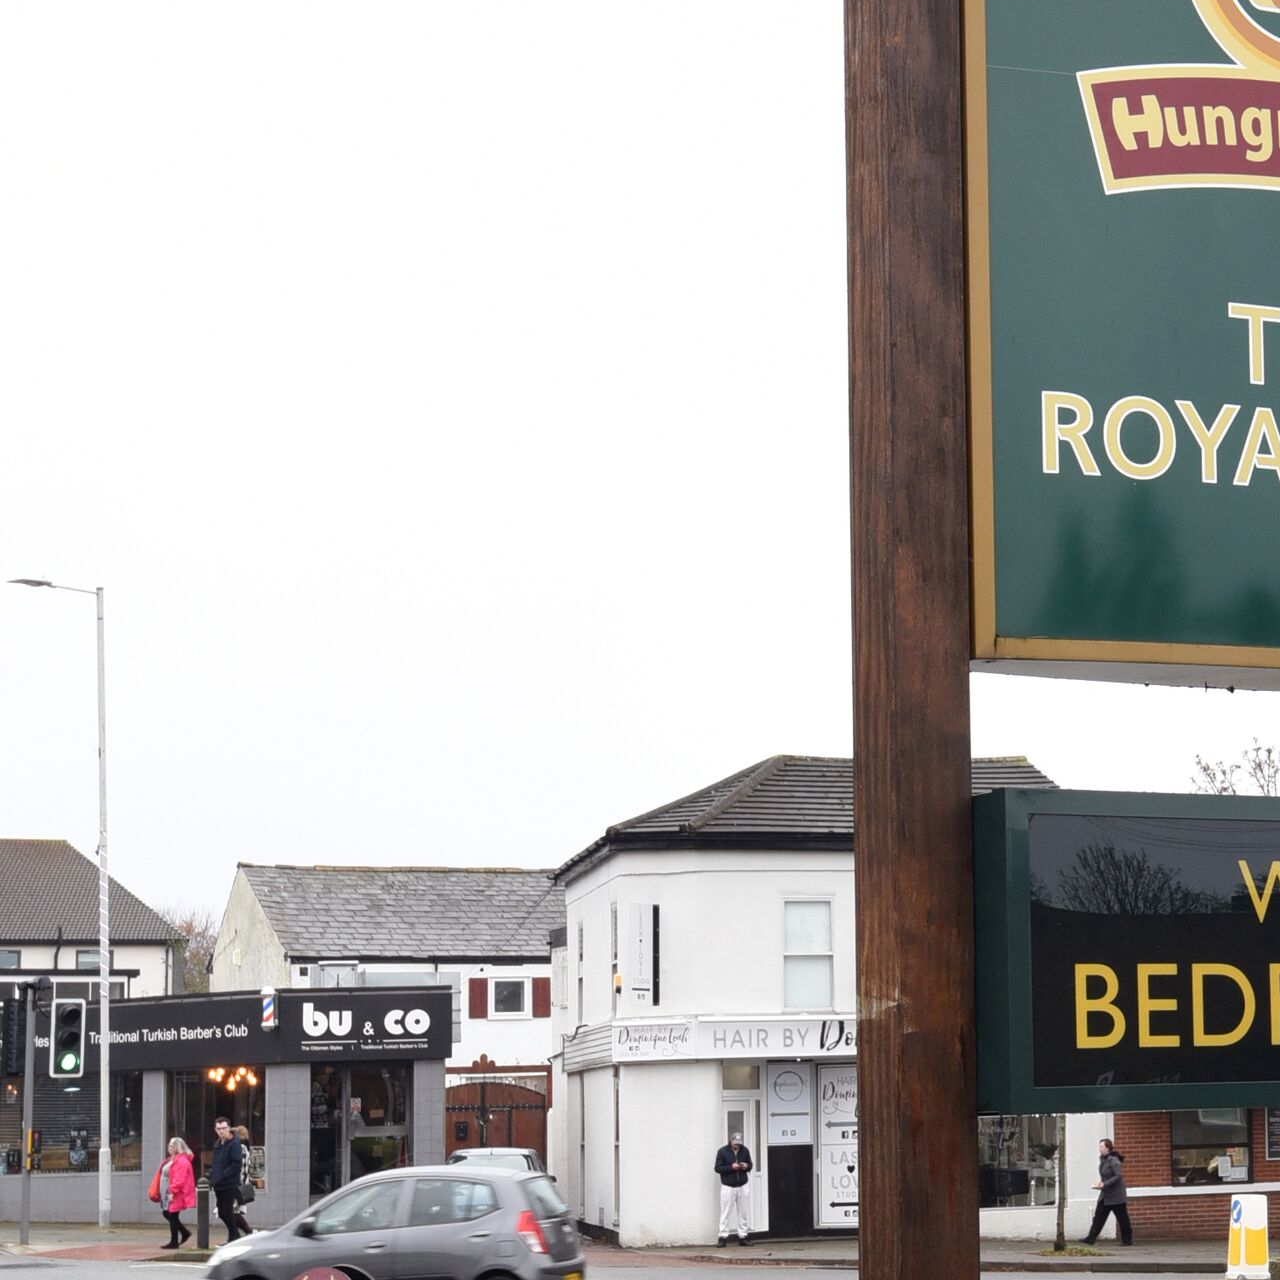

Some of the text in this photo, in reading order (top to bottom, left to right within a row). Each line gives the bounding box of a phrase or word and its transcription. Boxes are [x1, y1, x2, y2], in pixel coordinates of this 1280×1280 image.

[302, 1002, 431, 1037] bu & co
[89, 1028, 139, 1045] Tritional
[142, 1027, 178, 1043] Turkish
[180, 1025, 222, 1040] Barber's
[224, 1023, 248, 1037] Club
[713, 1027, 769, 1049] HAIR
[782, 1027, 810, 1048] BY
[830, 1151, 858, 1165] LAS
[831, 1174, 858, 1189] LOV
